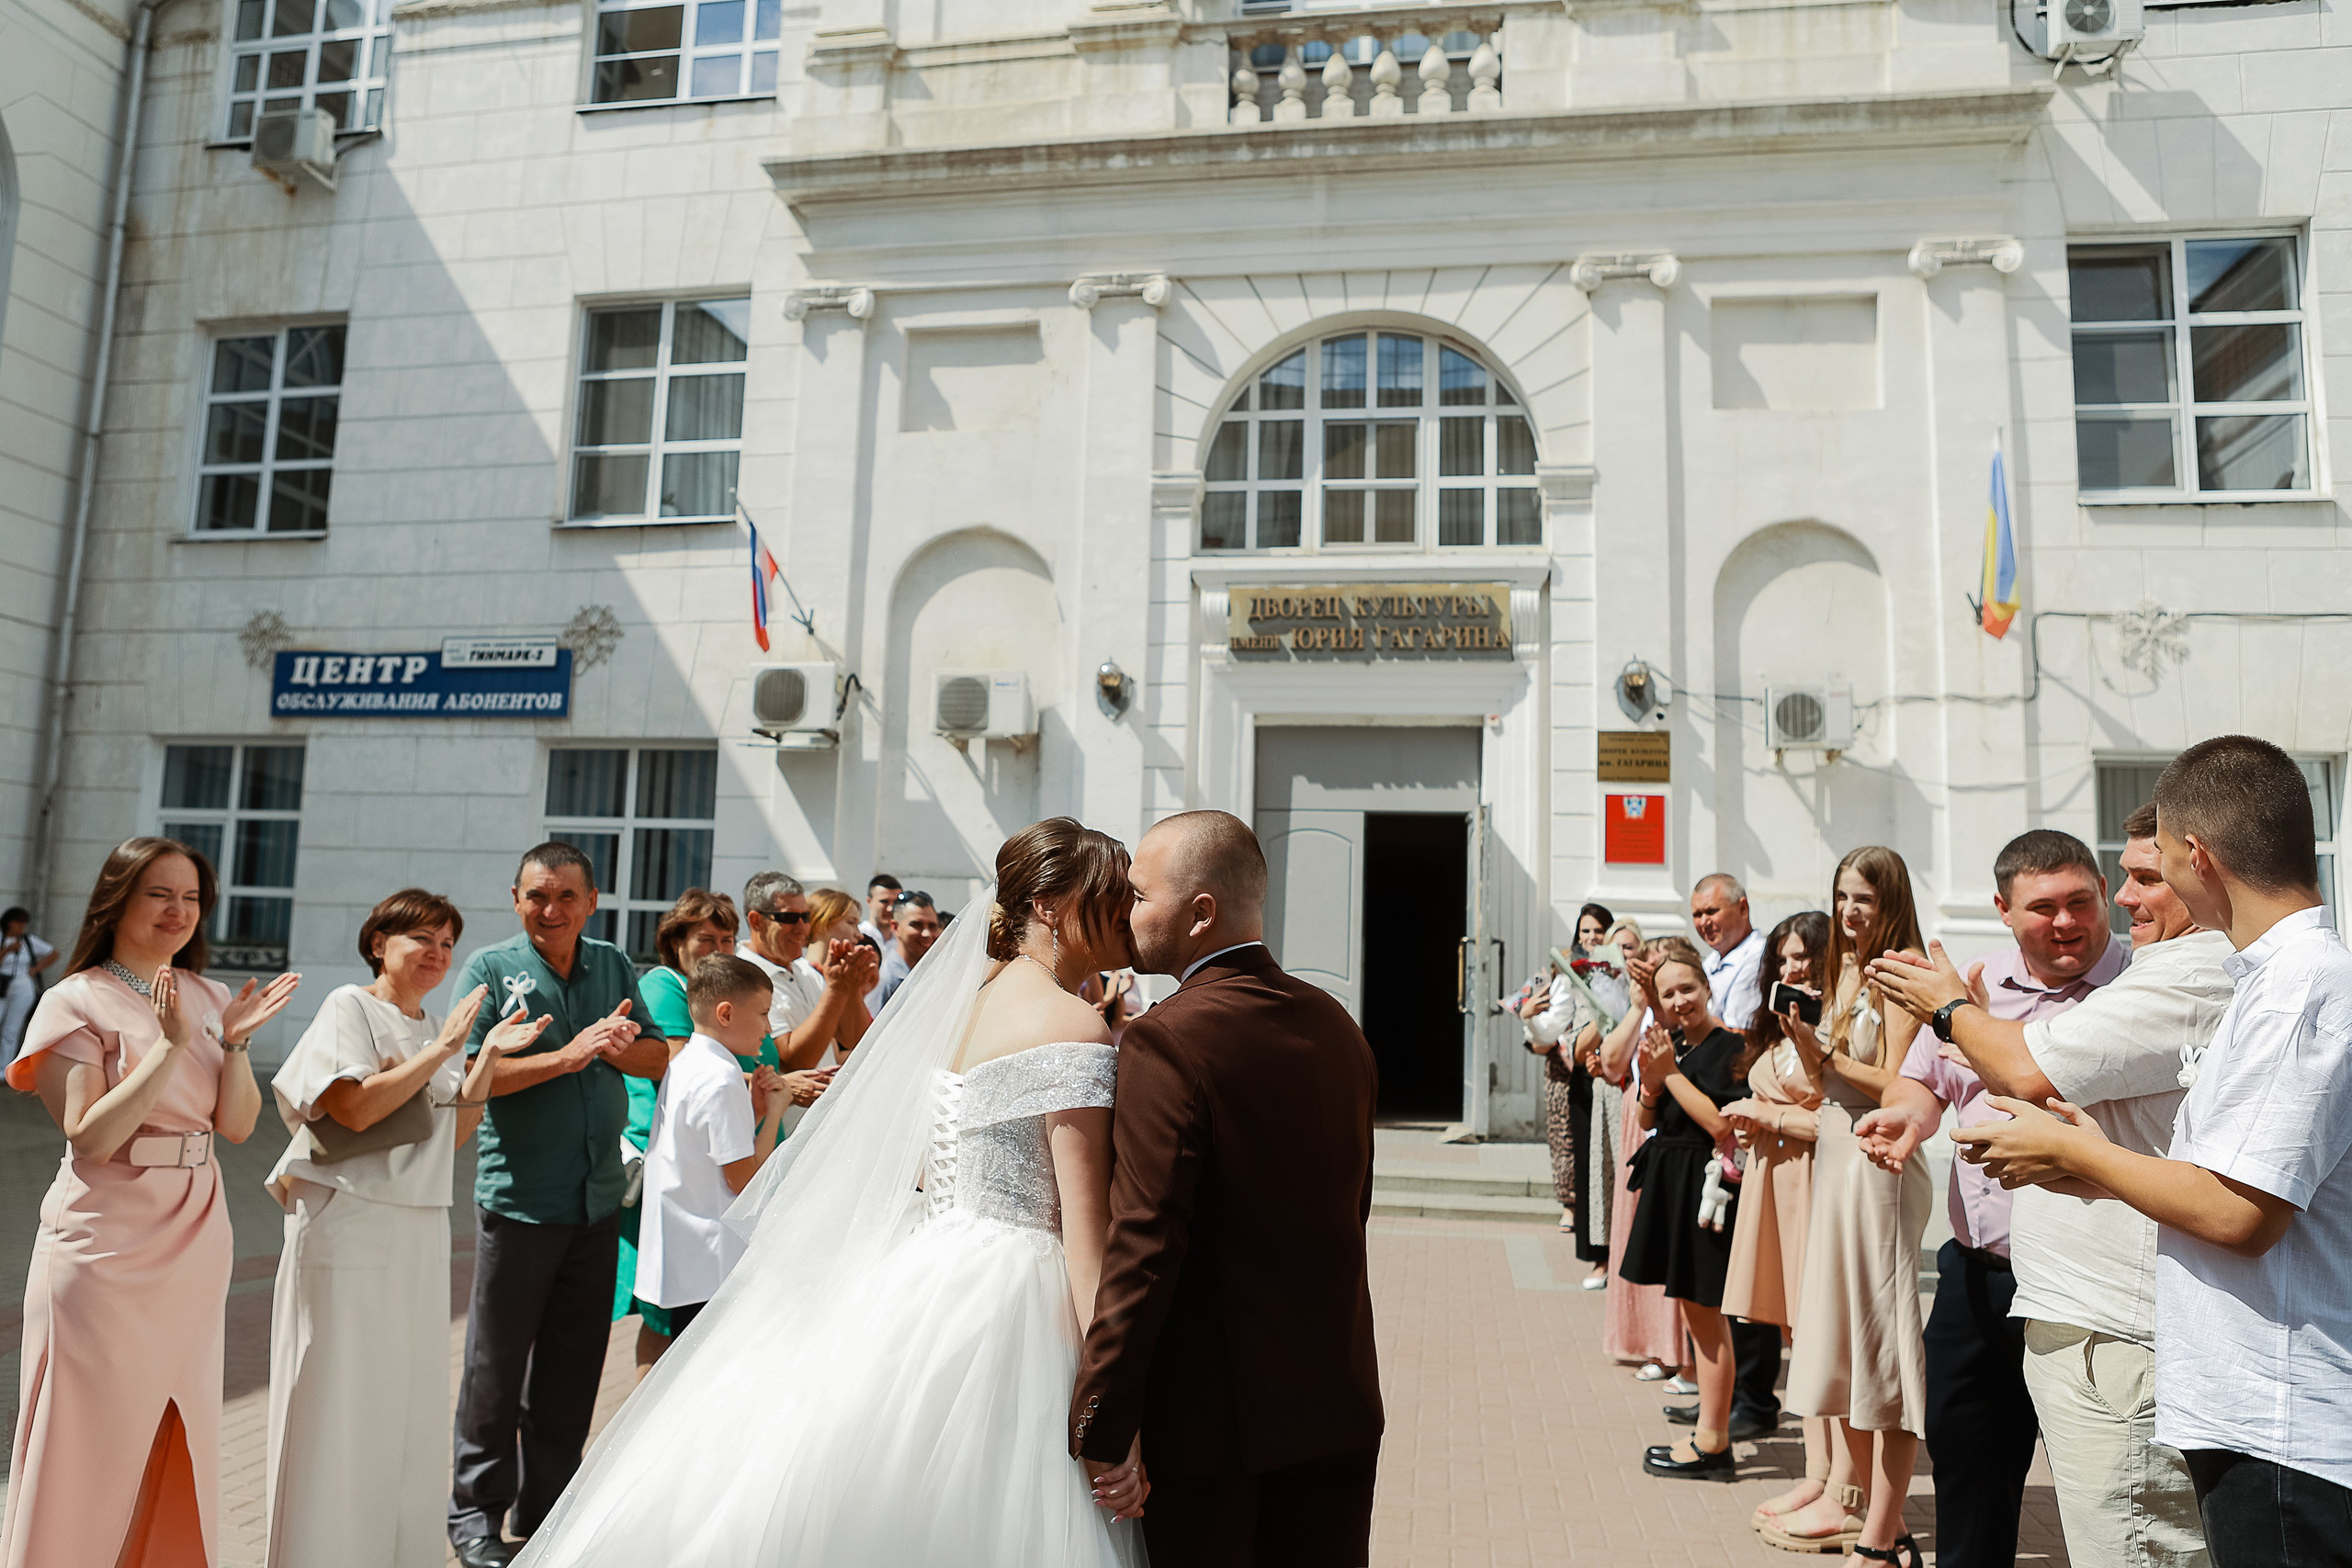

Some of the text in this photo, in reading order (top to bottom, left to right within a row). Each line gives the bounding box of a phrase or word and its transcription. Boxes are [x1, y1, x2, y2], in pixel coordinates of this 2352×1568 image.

[1249, 596, 1493, 623] ДВОРЕЦ КУЛЬТУРЫ
[1290, 626, 1365, 649] ЮРИЯ
[1375, 626, 1510, 650] ГАГАРИНА
[289, 656, 429, 686] ЦЕНТР
[277, 693, 563, 711] ОБСЛУЖИВАНИЯ АБОНЕНТОВ
